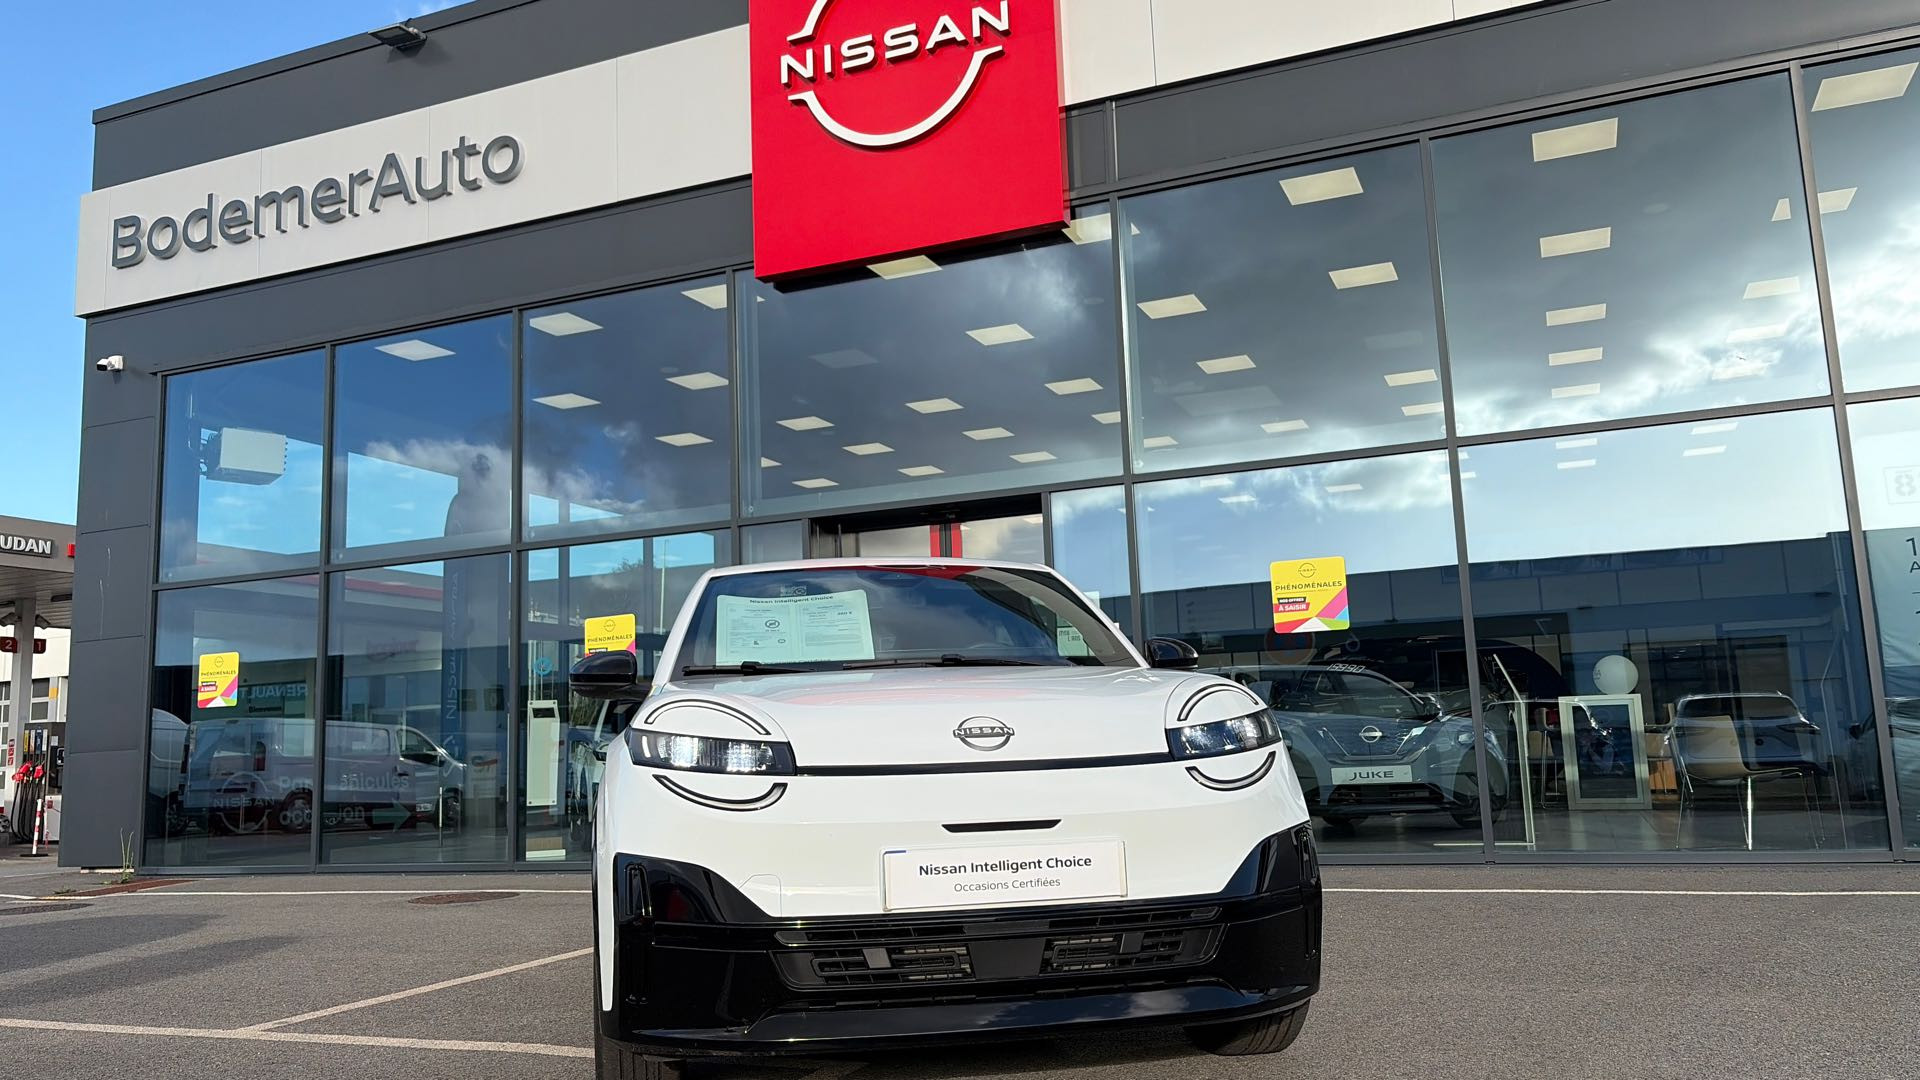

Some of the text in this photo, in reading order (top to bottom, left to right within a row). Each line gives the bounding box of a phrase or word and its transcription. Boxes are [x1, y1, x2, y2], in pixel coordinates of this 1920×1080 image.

[780, 0, 1010, 86] NISSAN
[112, 135, 523, 269] BodemerAuto
[1275, 580, 1343, 591] PHÉNOMÉNALES
[5, 640, 13, 650] 2
[955, 727, 1014, 736] NISSAN
[1348, 770, 1395, 781] JUKE
[919, 855, 1092, 876] Nissan Intelligent Choice
[954, 877, 1061, 892] Occasions Certifiées
